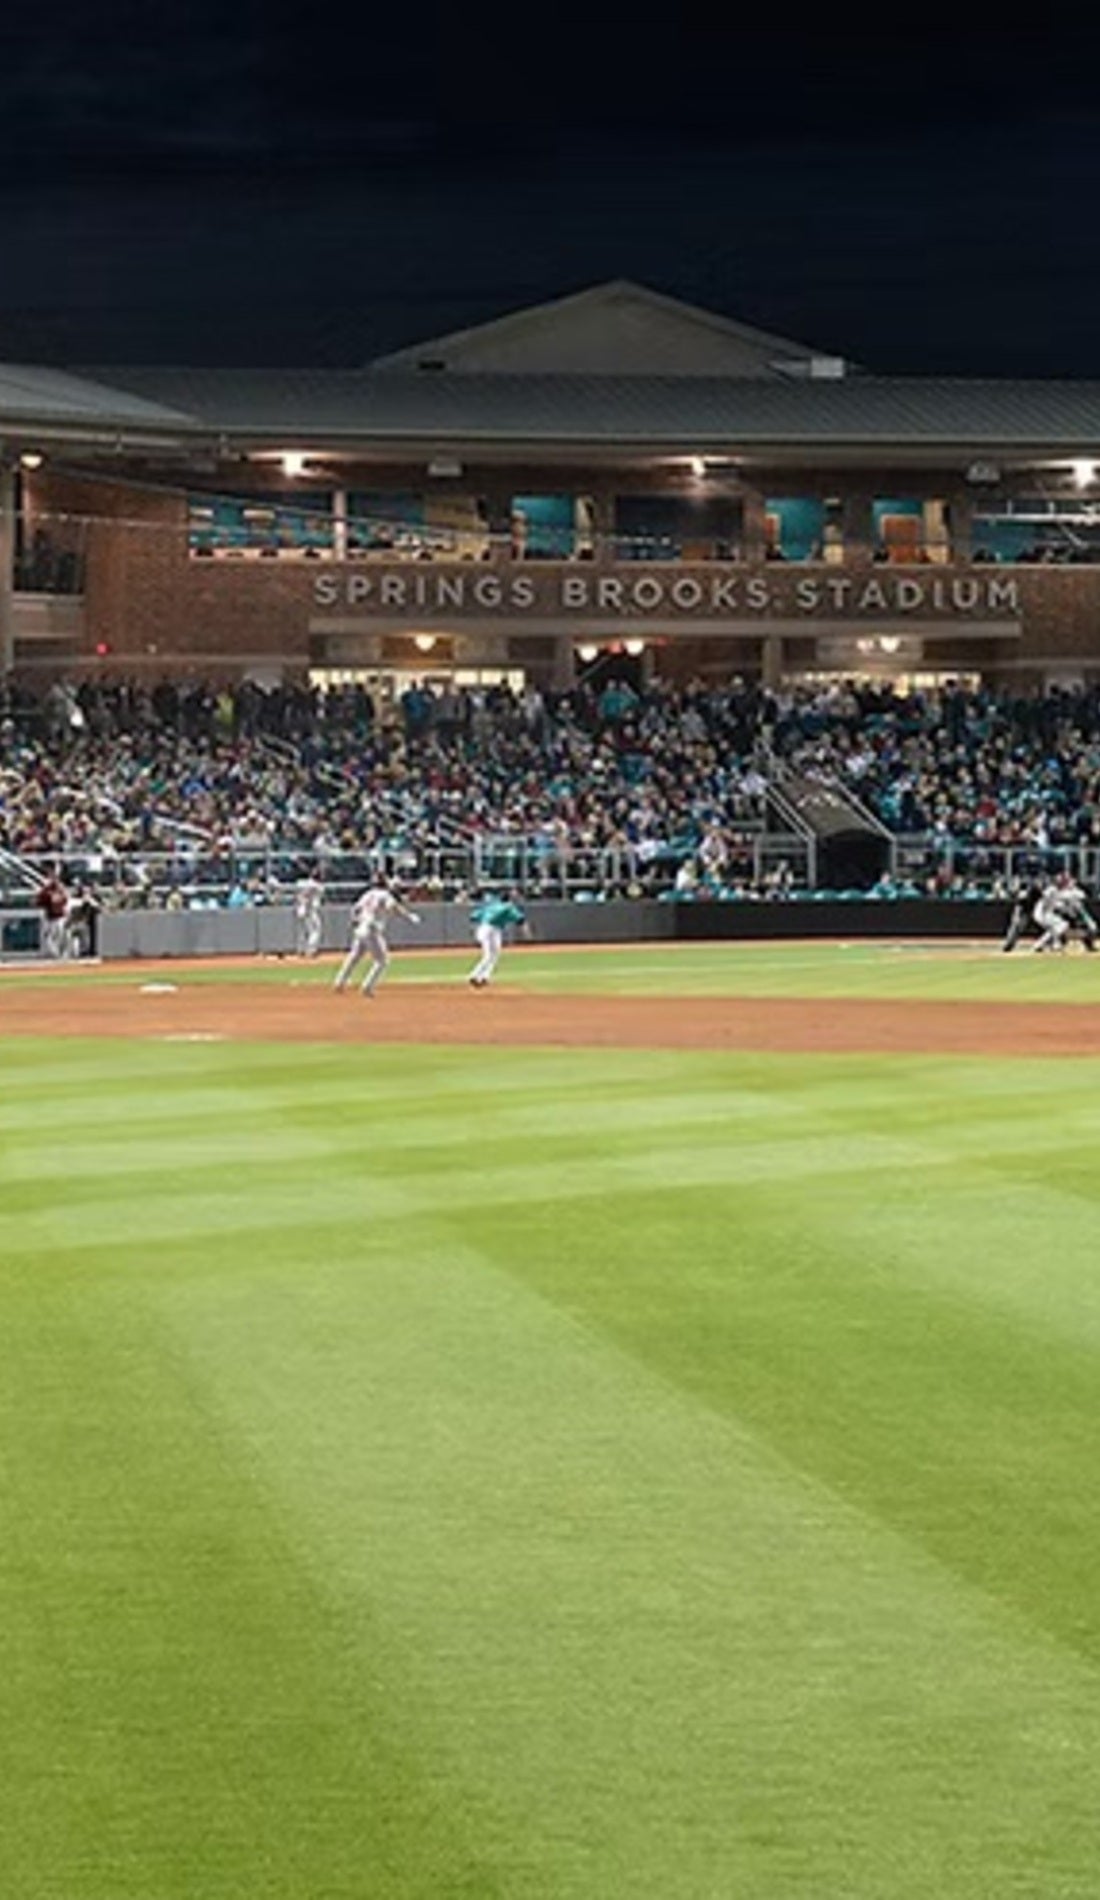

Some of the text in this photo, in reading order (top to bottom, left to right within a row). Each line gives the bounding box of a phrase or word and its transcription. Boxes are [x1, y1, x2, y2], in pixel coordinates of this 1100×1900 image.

[314, 574, 1019, 610] SPRINGS BROOKS STADIUM
